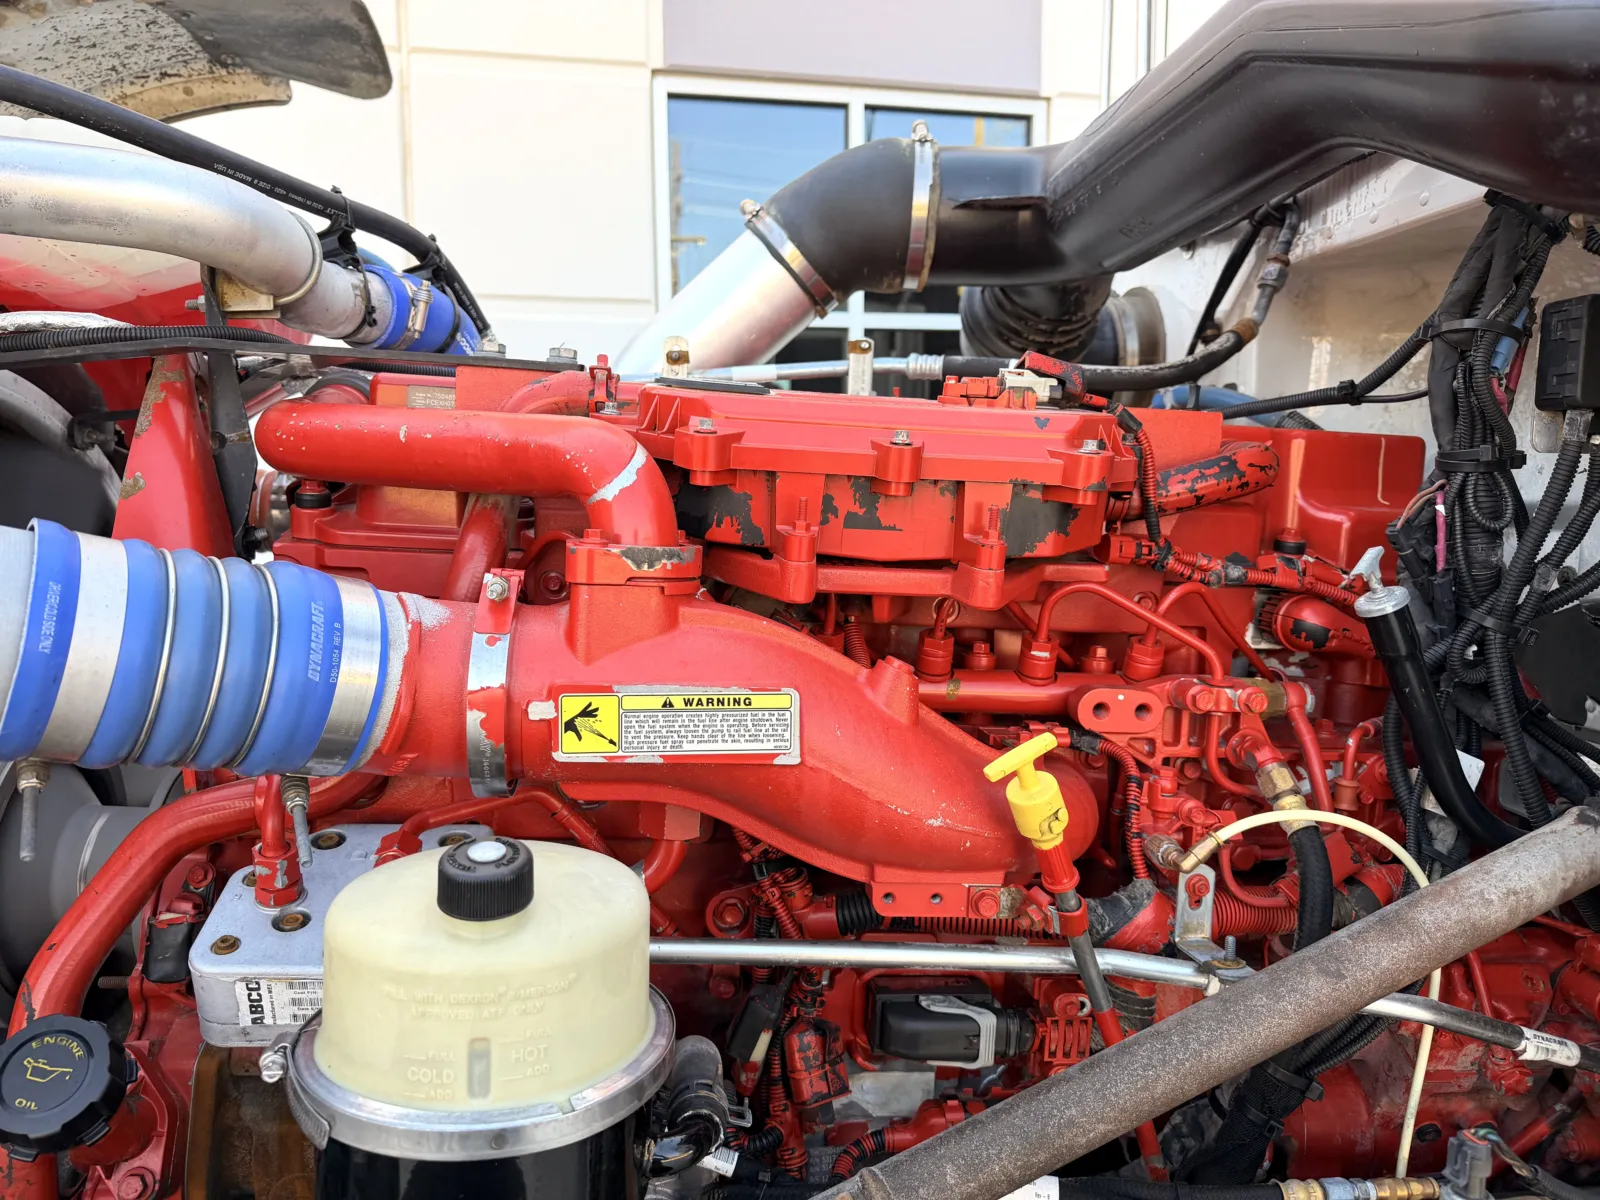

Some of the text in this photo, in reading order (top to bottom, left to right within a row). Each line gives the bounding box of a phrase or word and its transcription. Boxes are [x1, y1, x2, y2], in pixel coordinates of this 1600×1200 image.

[214, 163, 226, 171] USA
[234, 170, 252, 182] MADE
[42, 620, 55, 636] SIDE
[39, 636, 53, 654] ONLY
[308, 602, 324, 681] DYNACRAFT
[330, 650, 339, 682] D50-1054
[683, 697, 752, 707] WARNING
[414, 990, 442, 1003] WITH
[412, 1001, 544, 1020] APPROVED ATF ONLY
[526, 1027, 553, 1039] FULL
[32, 1036, 85, 1060] ENGINE
[512, 1045, 547, 1063] HOT
[429, 1051, 455, 1061] FULL
[407, 1066, 454, 1084] COLD
[526, 1064, 549, 1077] ADD
[429, 1090, 452, 1099] ADD
[15, 1098, 38, 1110] OIL
